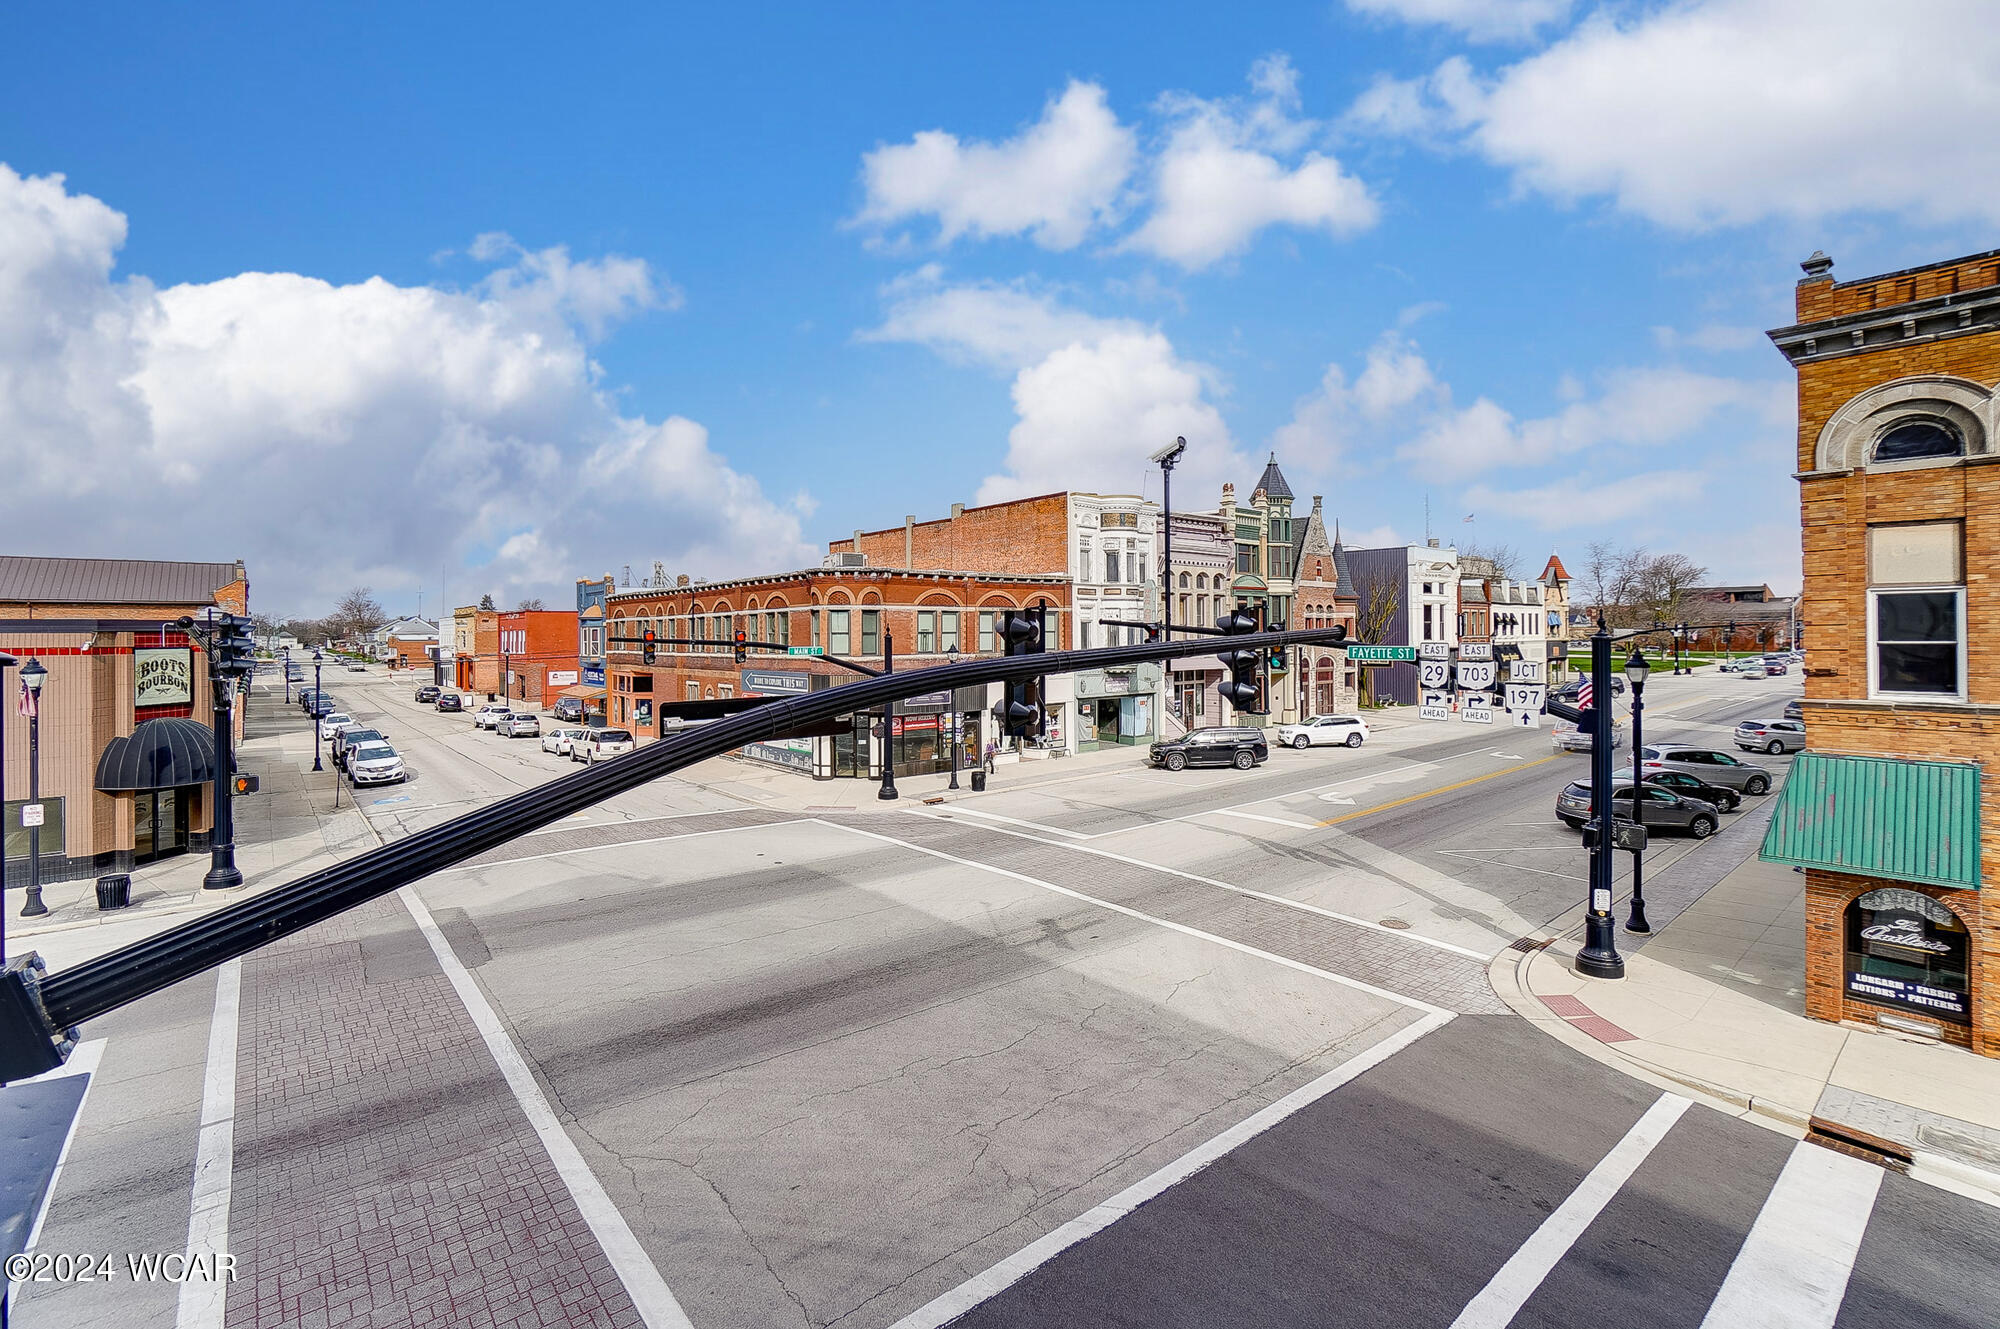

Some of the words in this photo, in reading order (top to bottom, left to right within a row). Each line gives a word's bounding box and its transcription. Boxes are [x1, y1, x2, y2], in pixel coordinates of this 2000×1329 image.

[1352, 647, 1393, 659] FAYETTE
[1398, 648, 1410, 659] ST
[1424, 644, 1445, 655] EAST
[1464, 645, 1487, 655] EAST
[140, 658, 186, 679] BOOTS
[1424, 665, 1444, 681] 29
[1462, 667, 1489, 681] 703
[1514, 664, 1537, 678] JCT
[137, 674, 188, 699] BOURBON
[783, 678, 795, 688] THIS
[1511, 690, 1539, 704] 197
[1422, 710, 1445, 718] AHEAD
[1465, 712, 1490, 720] AHEAD
[1850, 982, 1896, 998] NOTIONS
[1907, 994, 1963, 1012] PATTERNS
[1916, 985, 1957, 1000] FABRIC
